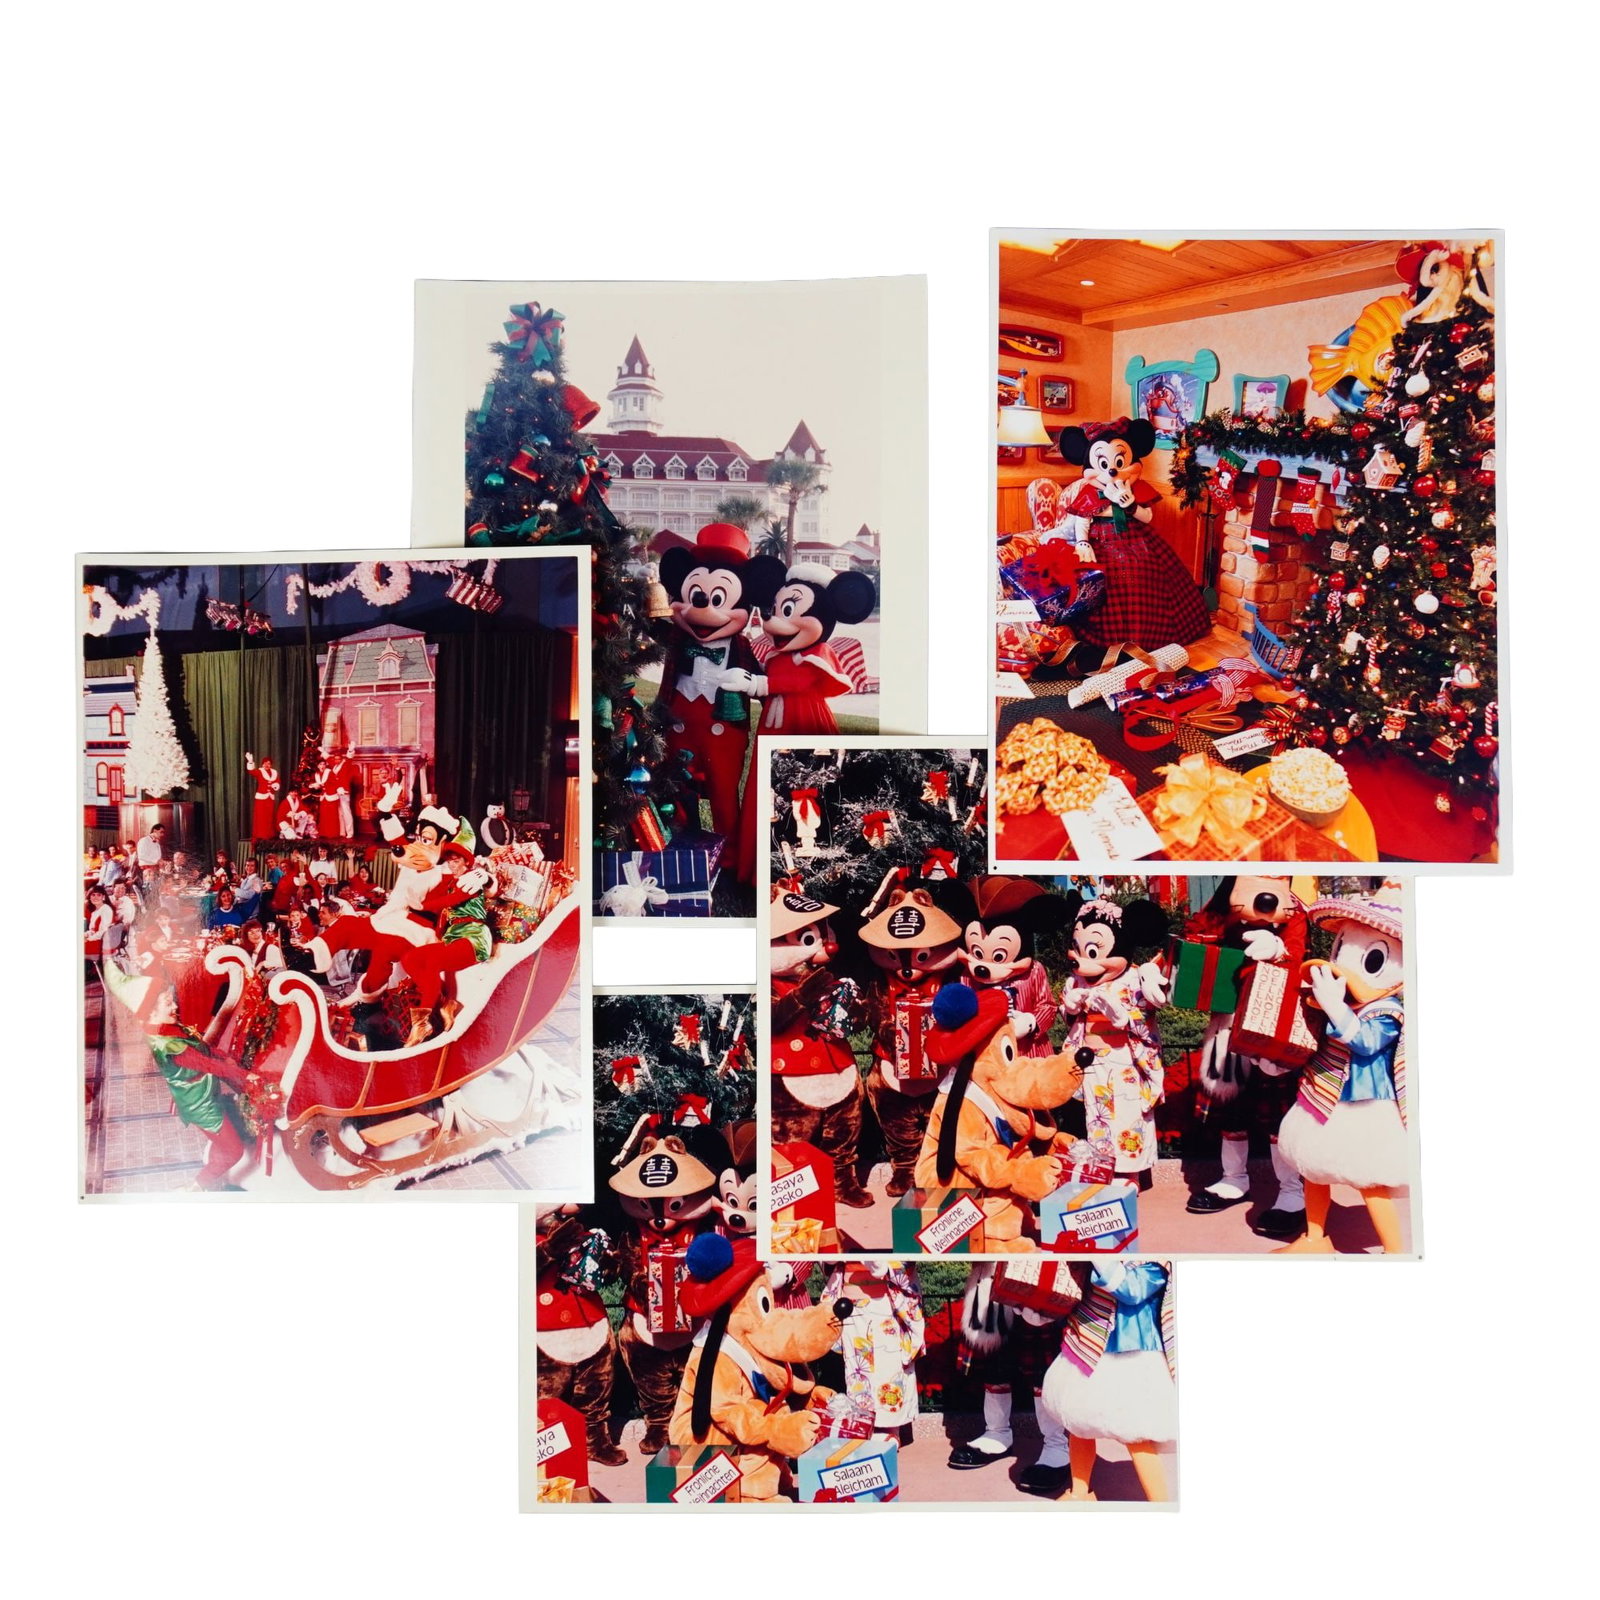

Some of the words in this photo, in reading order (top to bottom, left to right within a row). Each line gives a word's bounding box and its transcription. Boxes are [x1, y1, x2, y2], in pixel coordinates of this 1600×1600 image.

[1075, 1207, 1113, 1224] Salaam
[833, 1463, 873, 1482] Salaam
[689, 1469, 736, 1503] eihnachten
